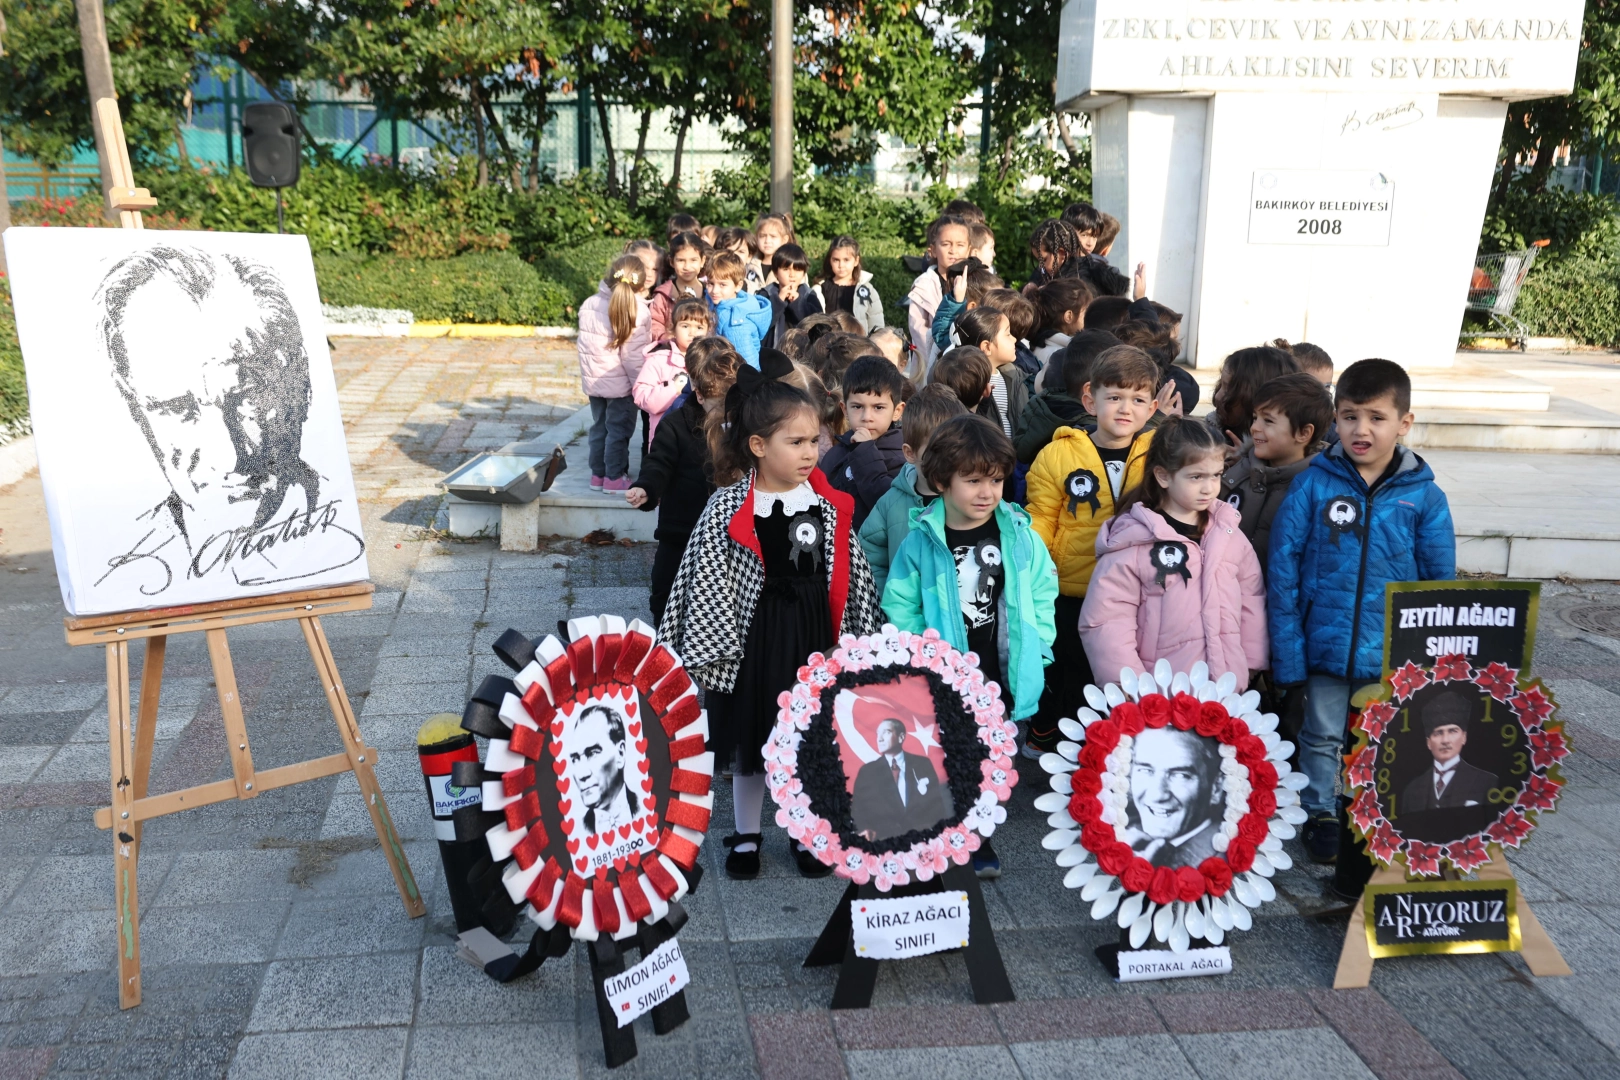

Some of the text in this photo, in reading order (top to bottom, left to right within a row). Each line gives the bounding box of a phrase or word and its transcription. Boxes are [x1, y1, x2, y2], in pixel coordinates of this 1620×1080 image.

[1293, 19, 1332, 40] VE
[1159, 55, 1514, 79] AHLAKLISINI SEVERIM
[1255, 199, 1388, 212] BAKIRKÖY BELEDİYESİ
[1297, 219, 1342, 235] 2008
[1399, 602, 1516, 628] ZEYTİN AĞACI
[1426, 636, 1479, 656] SINIFI
[866, 905, 961, 929] KİRAZ AĞACI
[895, 932, 935, 951] SINIFI
[606, 946, 682, 998] LİMON AĞACI
[1129, 958, 1223, 974] PORTAKAL AĞACI
[637, 982, 670, 1011] SINIFI
